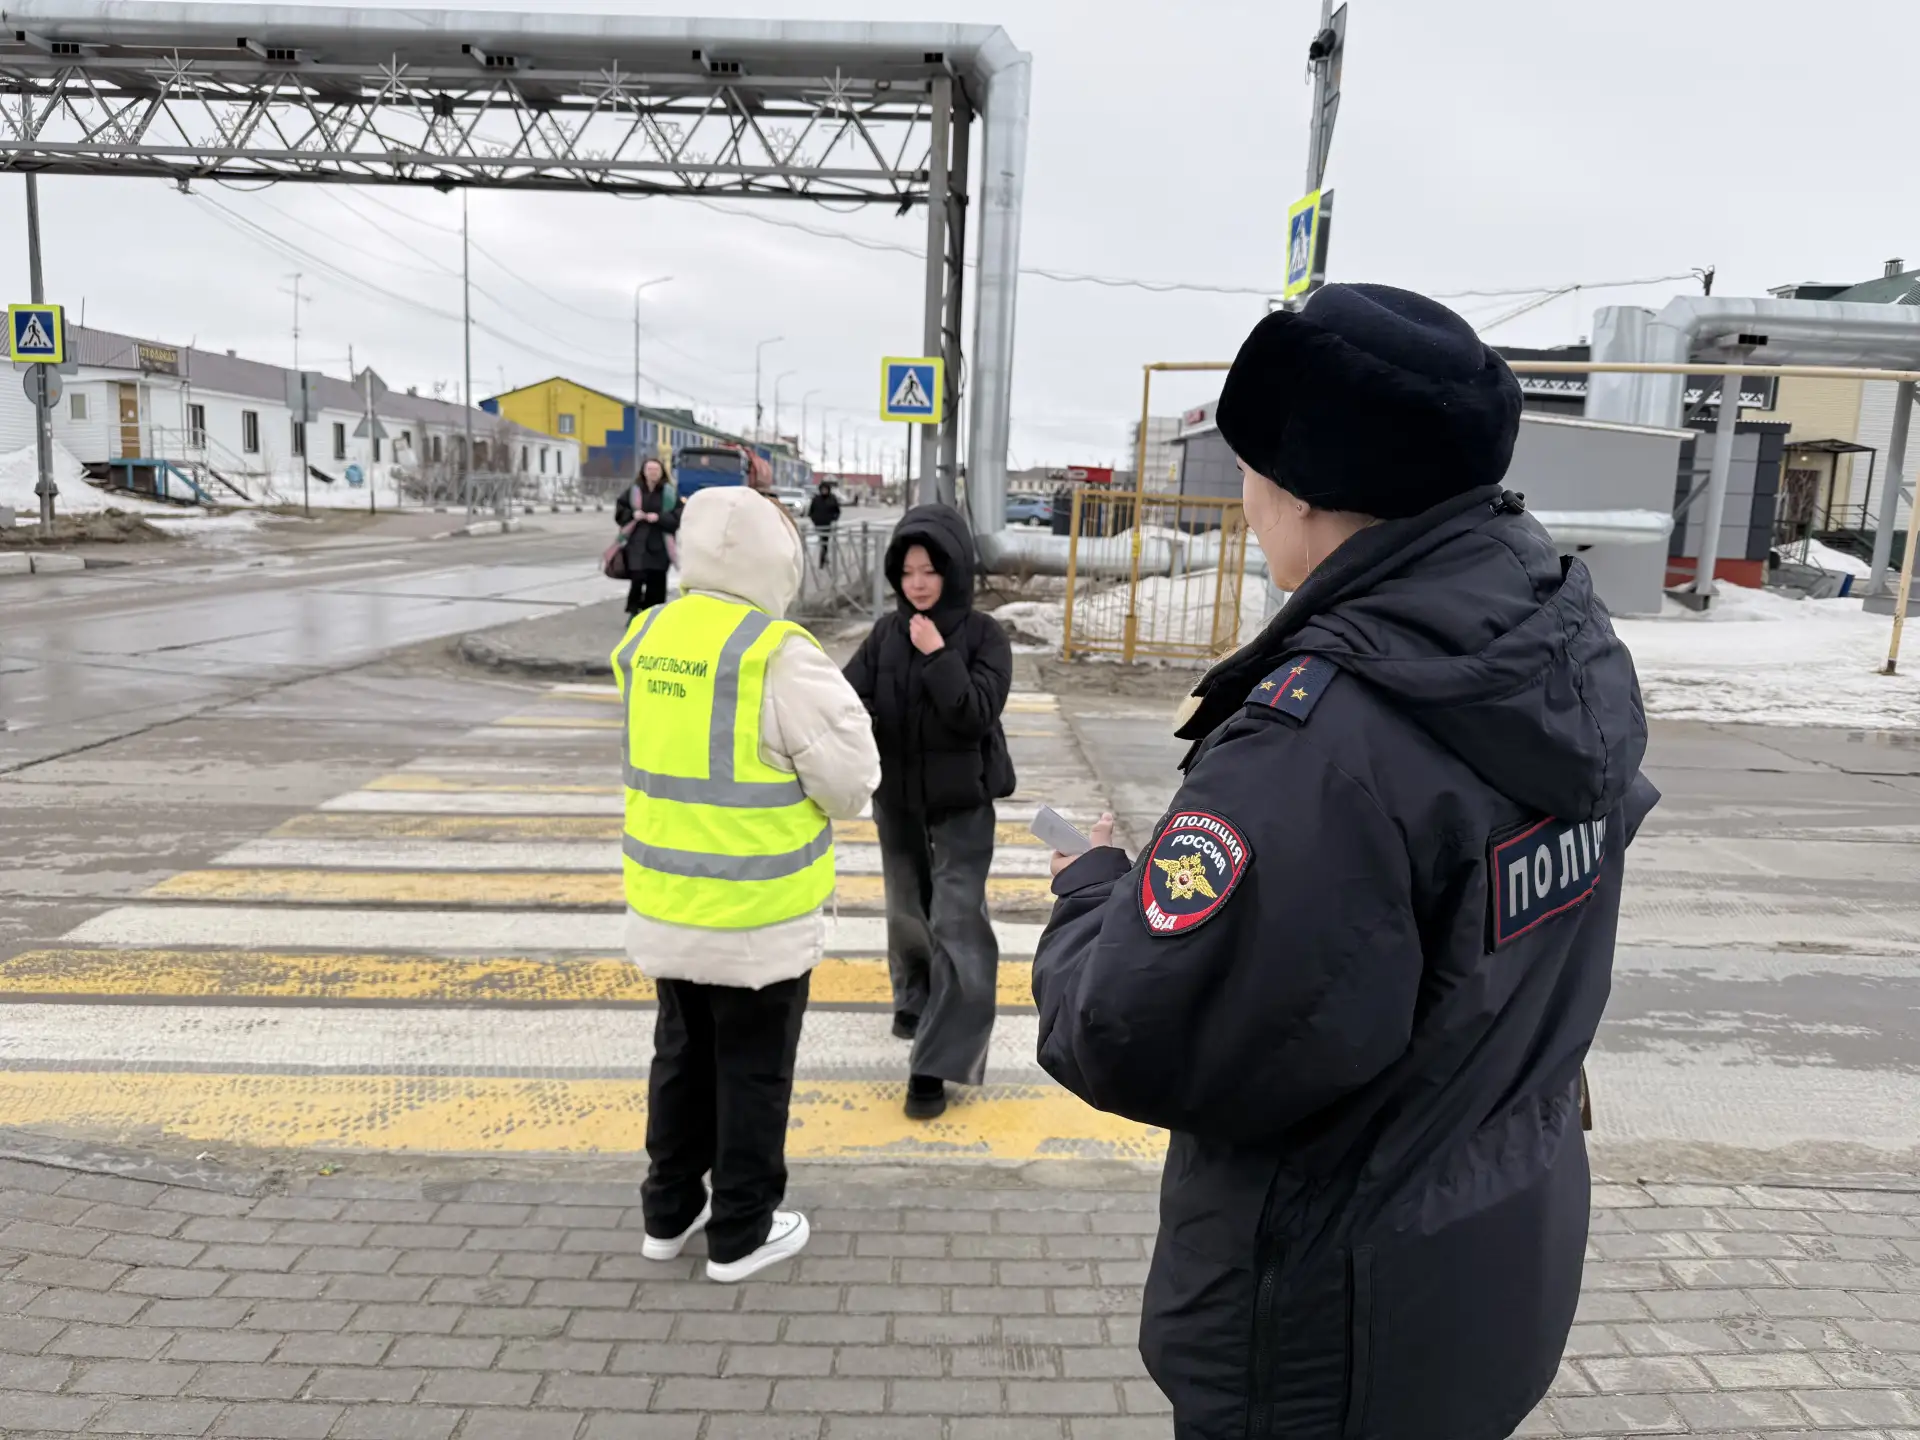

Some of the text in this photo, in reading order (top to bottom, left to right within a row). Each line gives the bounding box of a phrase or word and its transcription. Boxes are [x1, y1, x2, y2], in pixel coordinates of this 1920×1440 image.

[647, 679, 686, 698] ПАТРУЛЬ
[1171, 835, 1227, 875] РОССИЯ
[1172, 816, 1243, 865] ПОЛИЦИЯ
[1508, 817, 1607, 918] ПОЛИ
[1145, 900, 1178, 930] МВД
